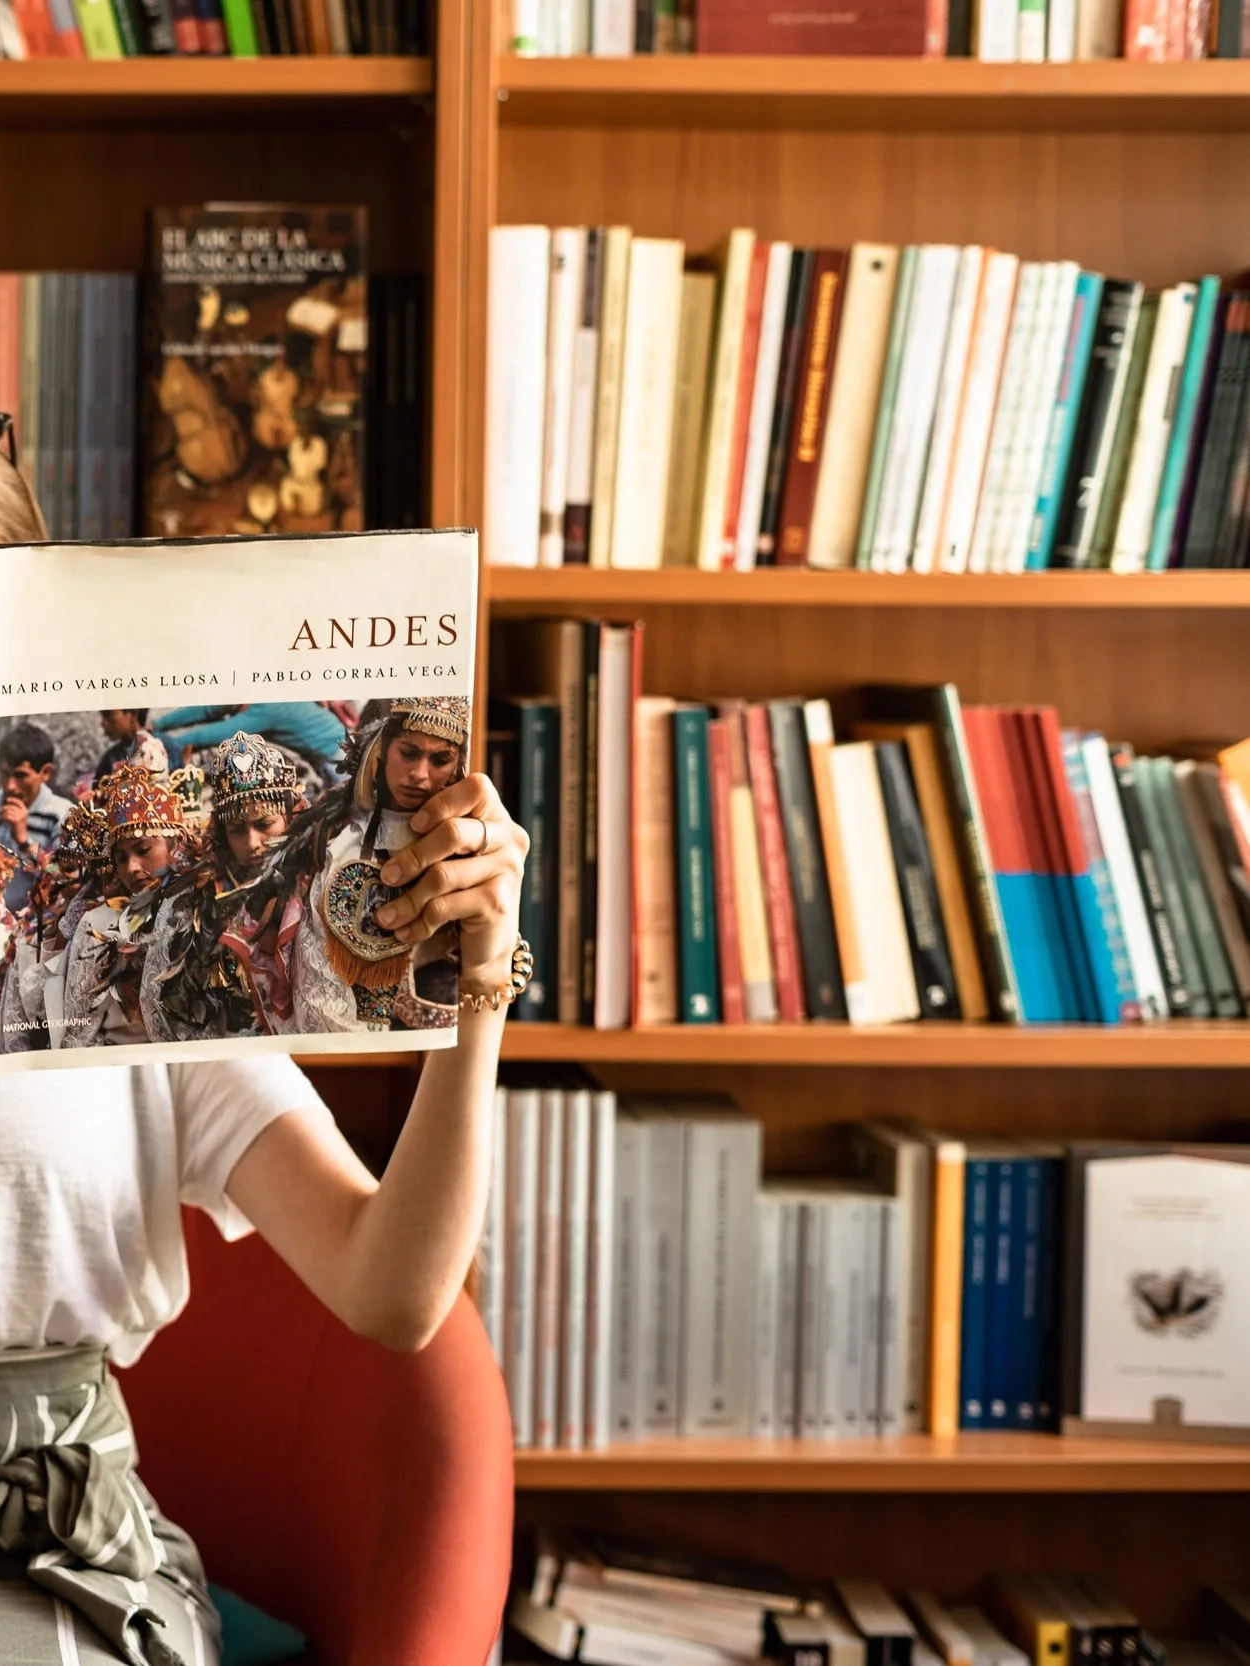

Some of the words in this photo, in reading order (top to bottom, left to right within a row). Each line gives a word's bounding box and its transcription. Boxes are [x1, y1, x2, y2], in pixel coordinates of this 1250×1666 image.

[288, 614, 459, 650] ANDES
[2, 681, 63, 694] MARIO
[75, 677, 149, 691] VARGAS
[160, 673, 220, 687] LLOSA
[252, 671, 312, 683] PABLO
[323, 667, 398, 680] CORRAL
[408, 665, 458, 678] VEGA
[3, 1020, 40, 1032] NATIONAL
[42, 1017, 92, 1028] GEOGRAPHIC
